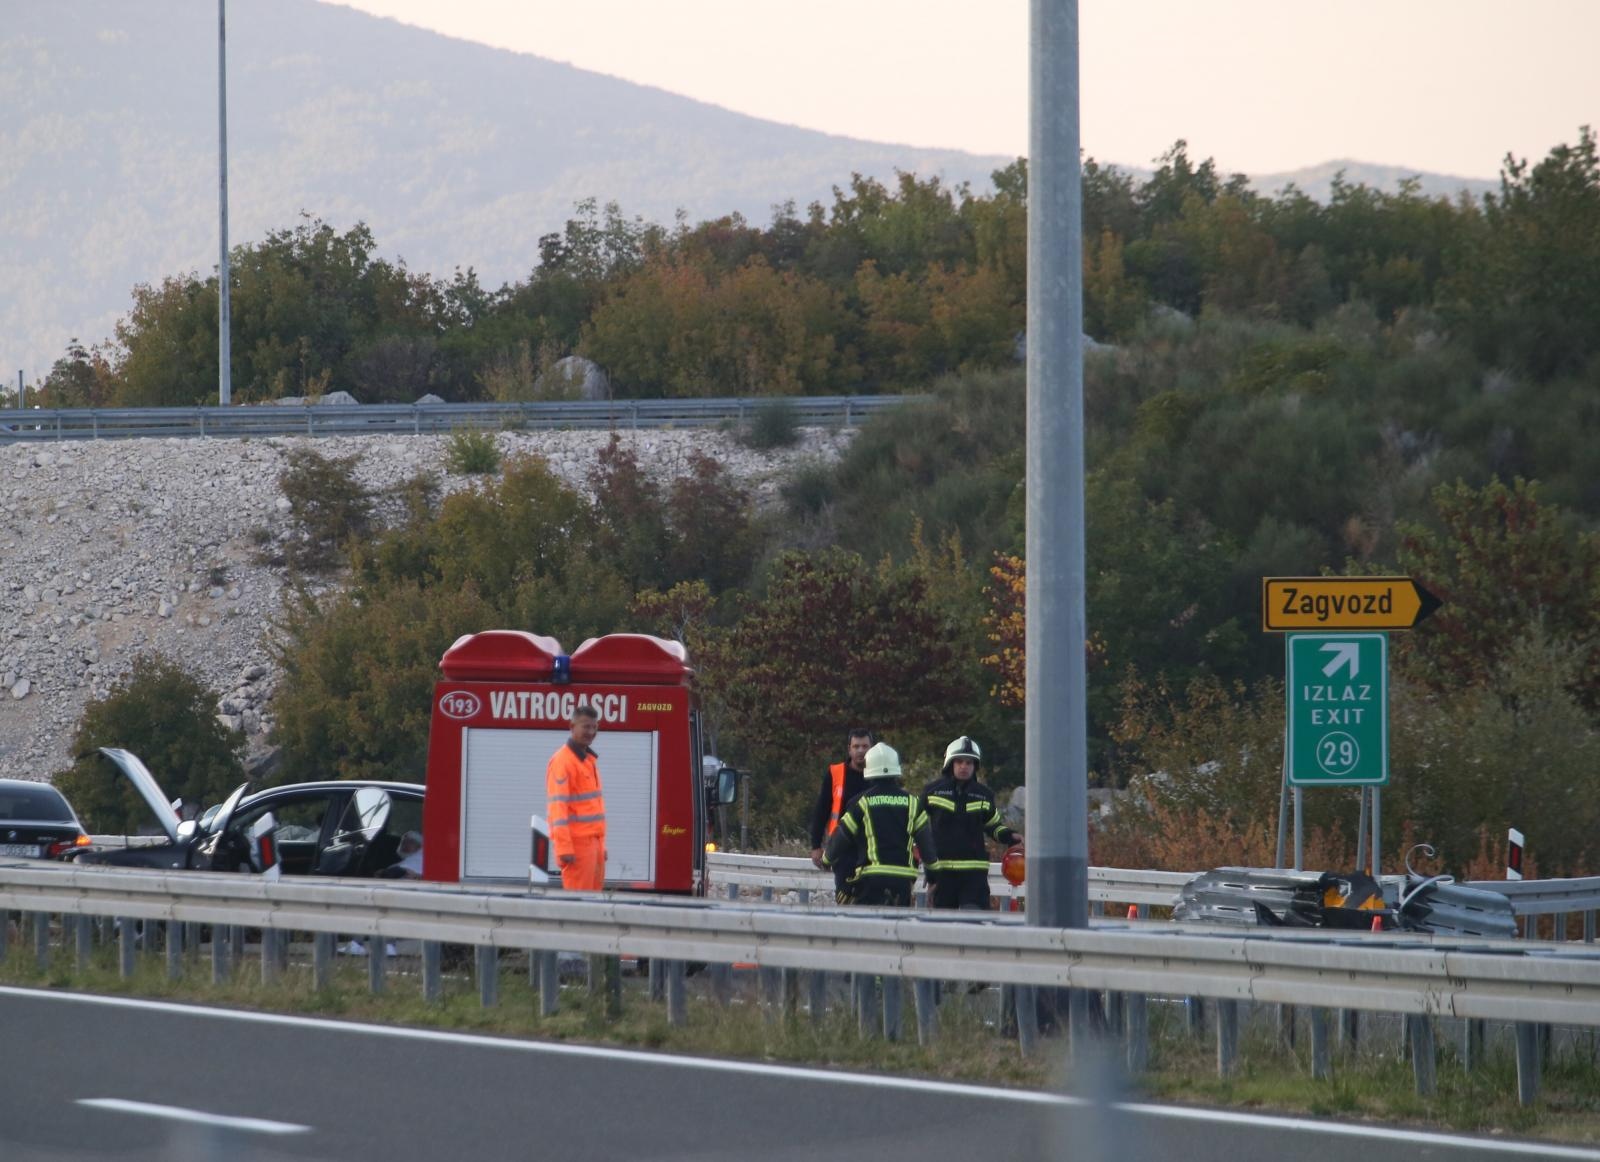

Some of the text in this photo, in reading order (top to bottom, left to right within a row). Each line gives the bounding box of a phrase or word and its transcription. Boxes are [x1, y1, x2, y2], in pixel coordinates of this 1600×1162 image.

[1282, 587, 1392, 622] Zagvozd
[1304, 685, 1371, 701] IZLAZ
[449, 699, 473, 713] 193
[1311, 708, 1365, 725] EXIT
[1323, 741, 1353, 766] 29
